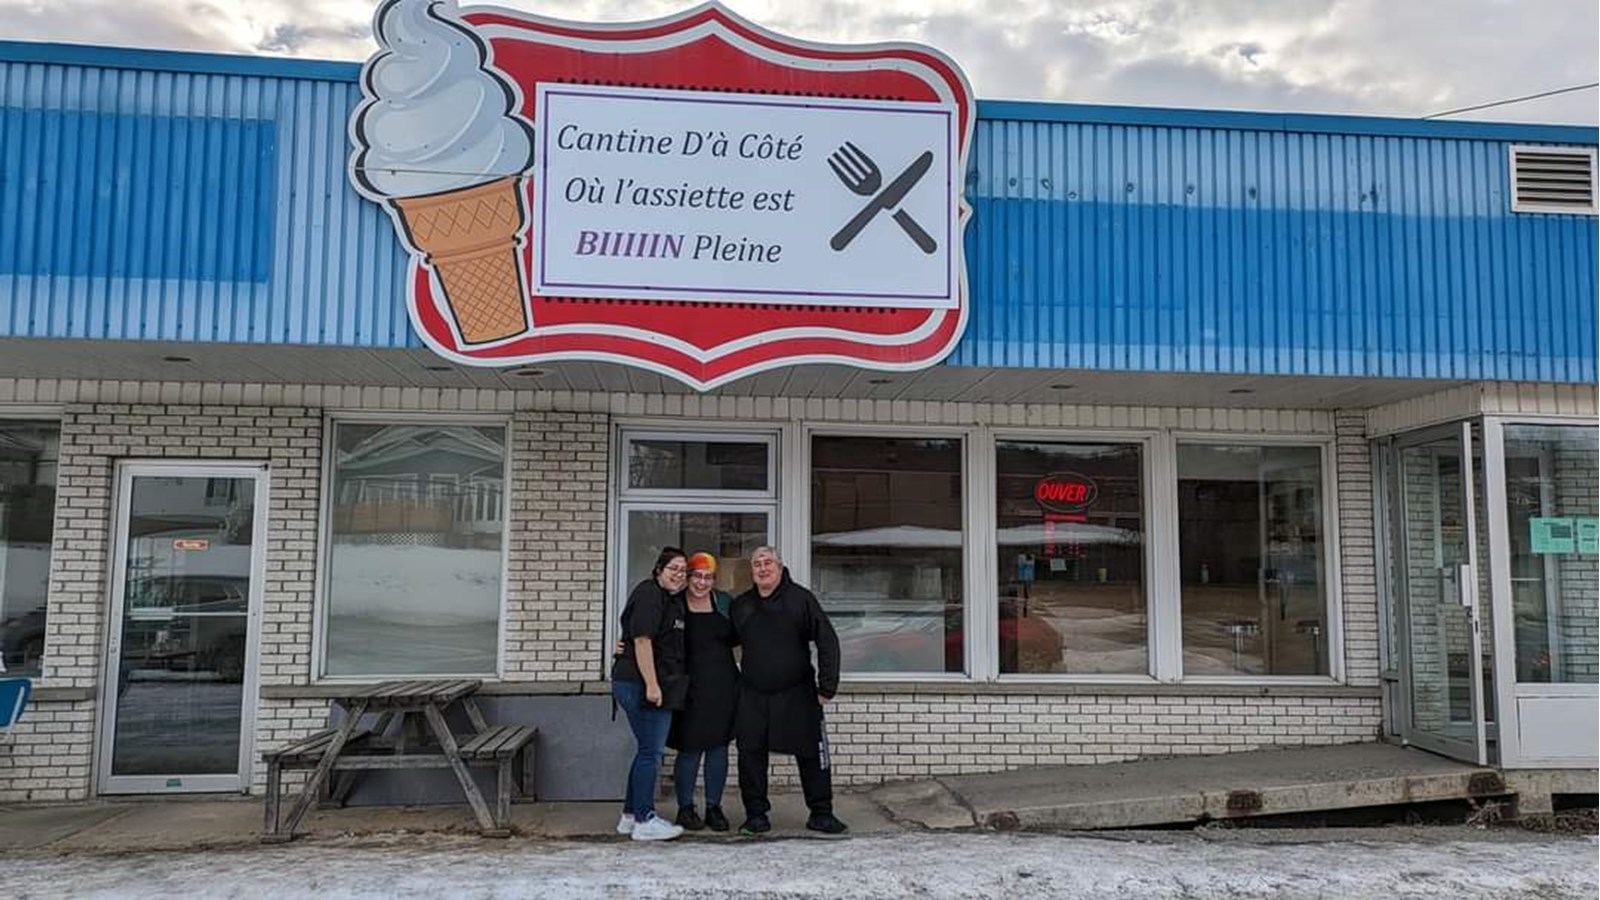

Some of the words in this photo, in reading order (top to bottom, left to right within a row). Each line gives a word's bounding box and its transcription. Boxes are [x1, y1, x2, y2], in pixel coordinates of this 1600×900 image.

[557, 124, 673, 155] Cantine
[681, 131, 729, 158] D’à
[738, 133, 803, 161] Côté
[565, 177, 605, 204] Où
[614, 178, 745, 211] l’assiette
[752, 191, 796, 212] est
[575, 230, 685, 259] BIIIIIN
[692, 234, 782, 263] Pleine
